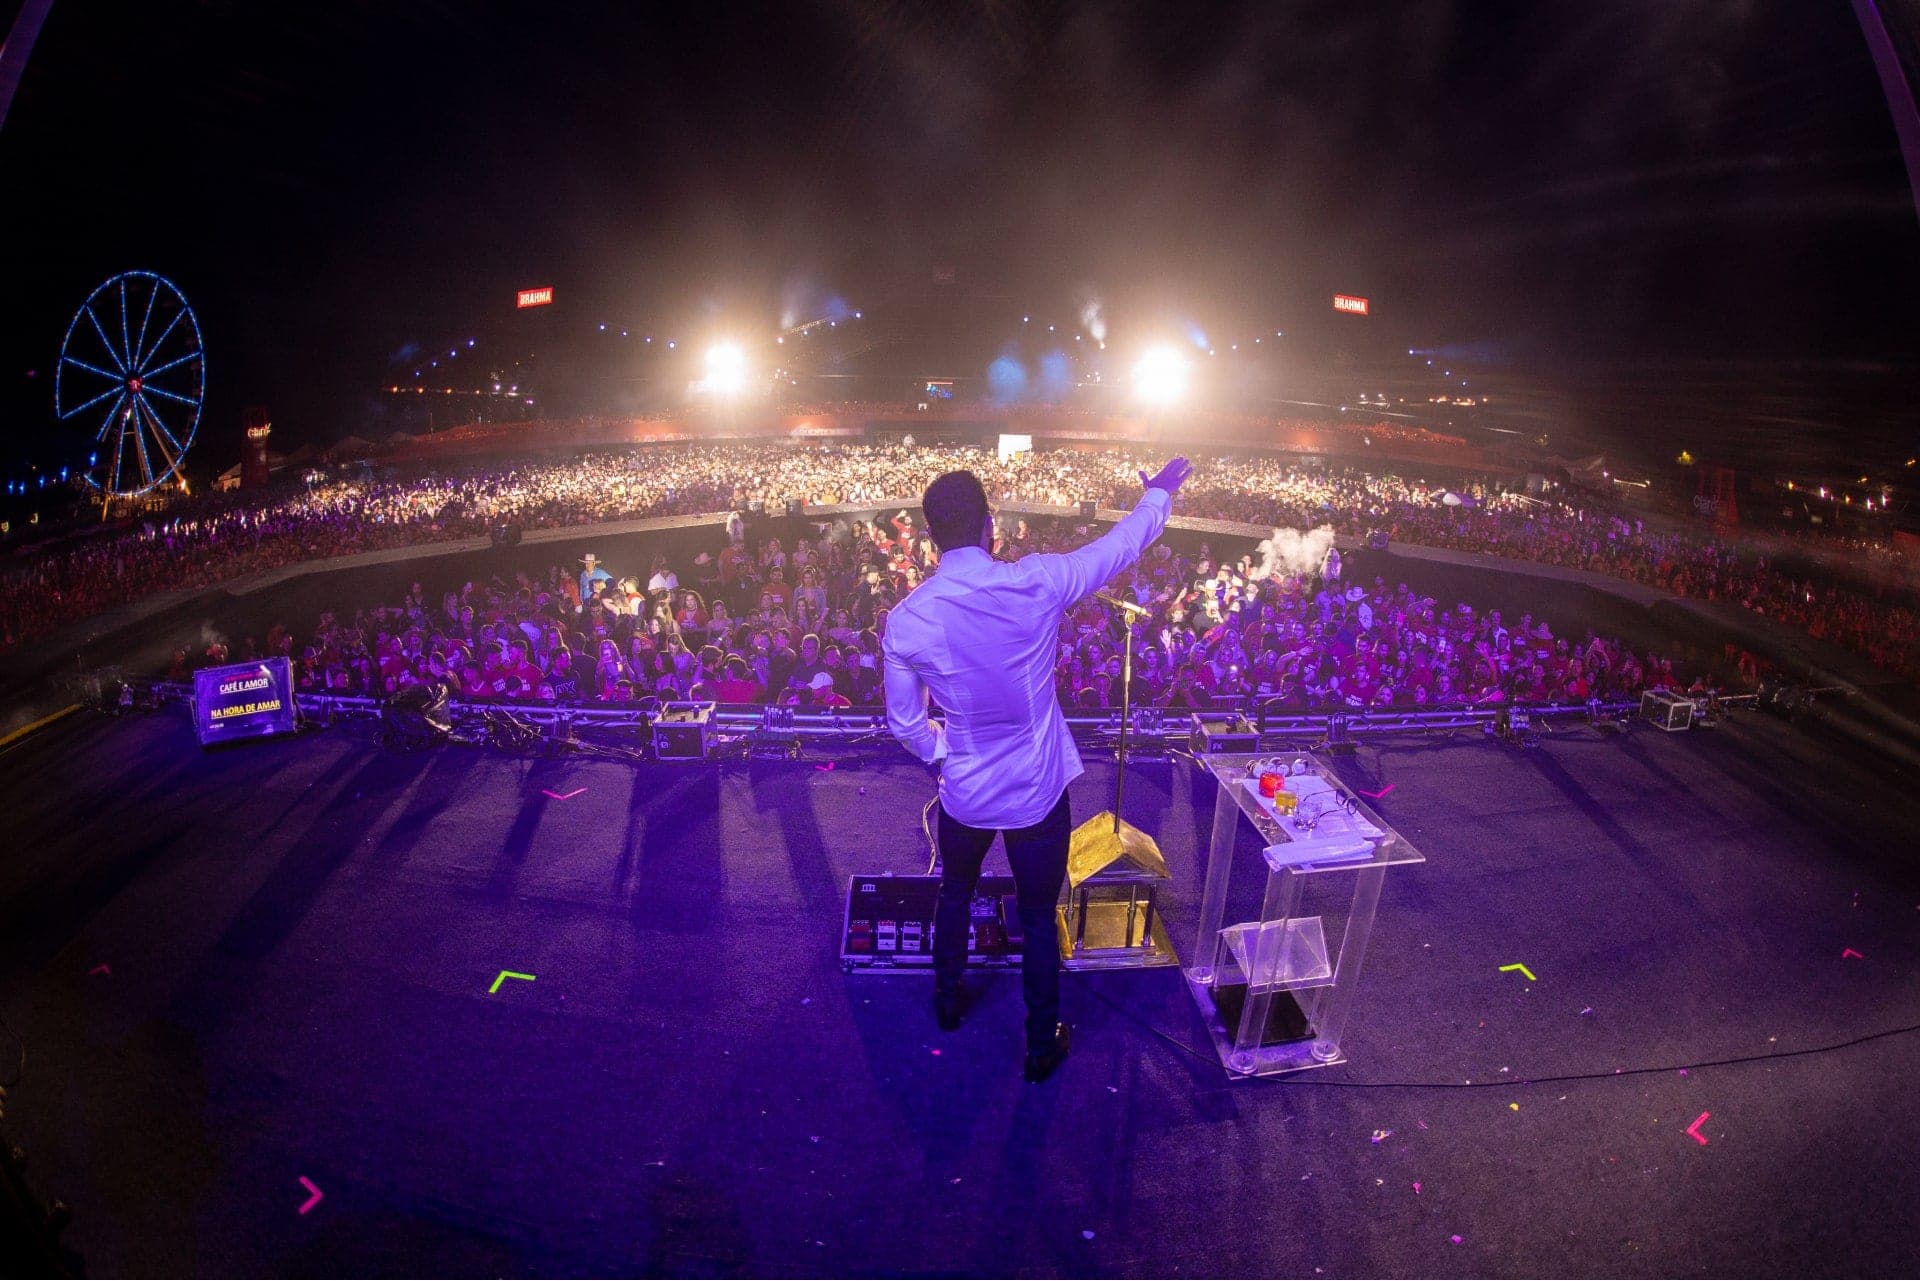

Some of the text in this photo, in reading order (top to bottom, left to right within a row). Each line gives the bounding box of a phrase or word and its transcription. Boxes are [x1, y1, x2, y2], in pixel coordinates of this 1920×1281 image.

[520, 291, 551, 305] BRAHMA
[1334, 297, 1366, 312] BRAHMA
[219, 681, 237, 693] CAFÉ
[244, 678, 269, 689] AMOR
[210, 700, 281, 718] NA HORA DE AMAR
